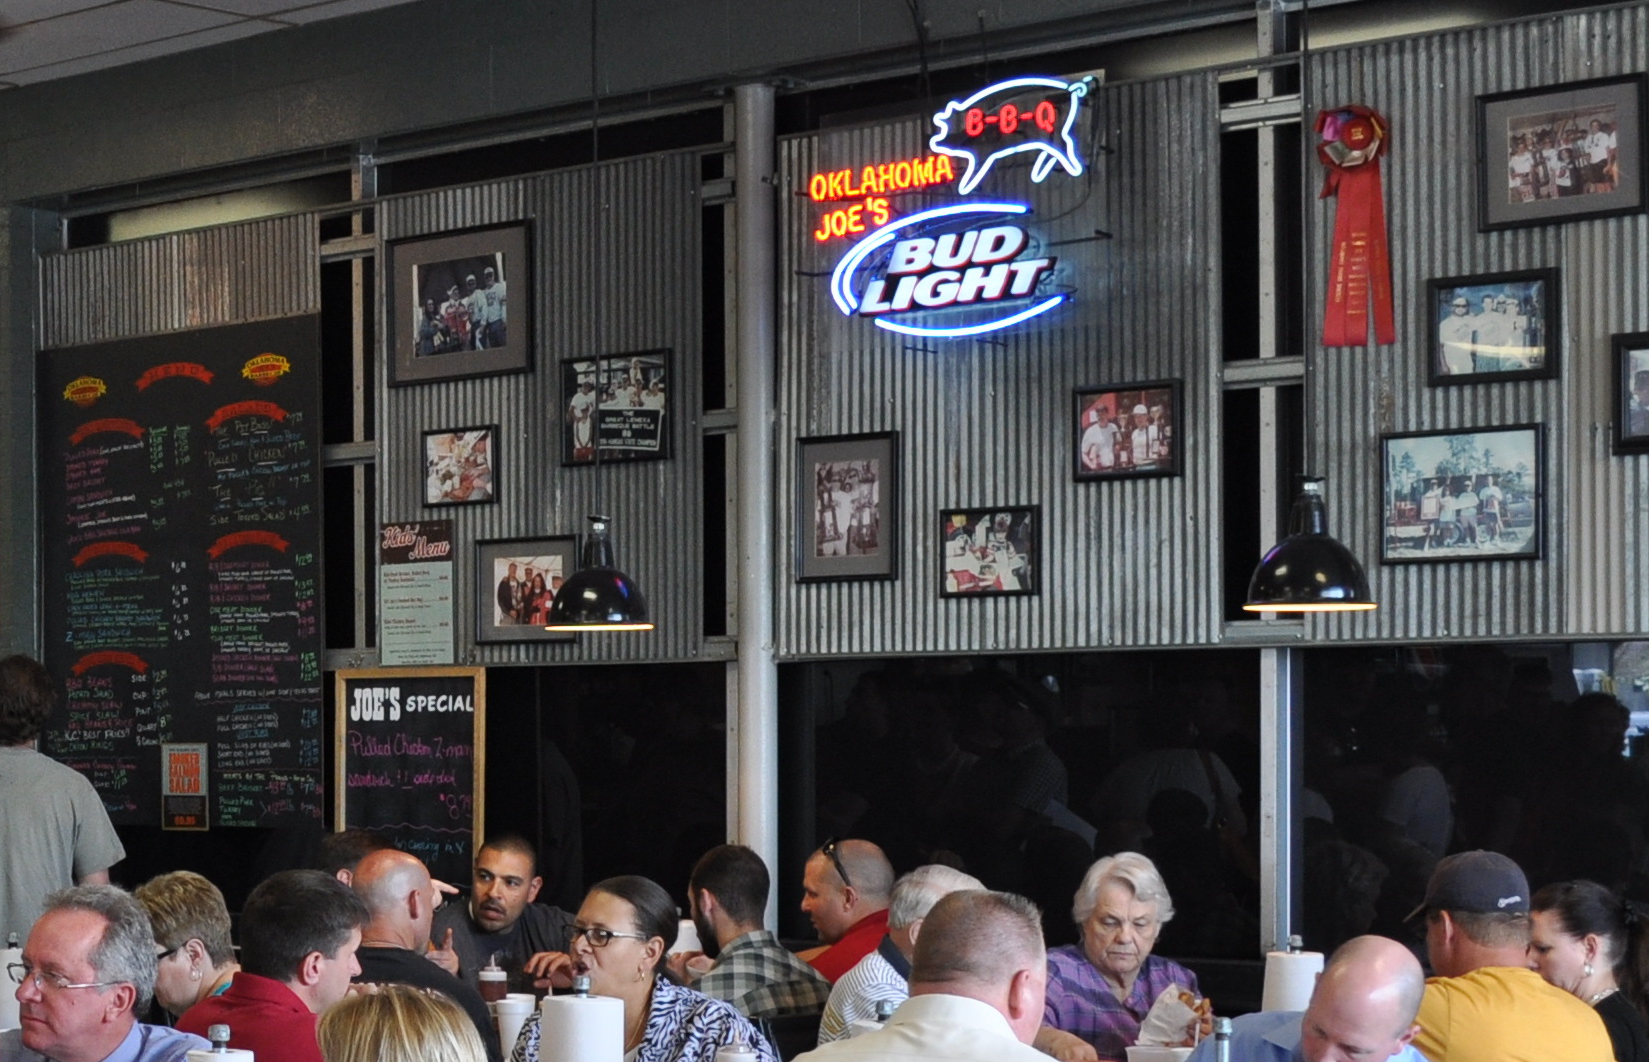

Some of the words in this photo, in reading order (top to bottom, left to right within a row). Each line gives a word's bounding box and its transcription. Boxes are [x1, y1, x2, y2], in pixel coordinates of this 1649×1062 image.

[965, 101, 1056, 137] B-B-Q
[809, 154, 954, 201] OKLAHOMA
[815, 196, 891, 243] JOE'S
[887, 225, 1029, 275] BUD
[859, 258, 1054, 316] LIGHT
[247, 355, 286, 368] OKLAHOMA
[382, 523, 420, 549] Kids'
[408, 536, 450, 560] Menu
[350, 686, 401, 721] JOE'S
[405, 694, 474, 713] SPECIAL
[347, 730, 391, 757] Pulled
